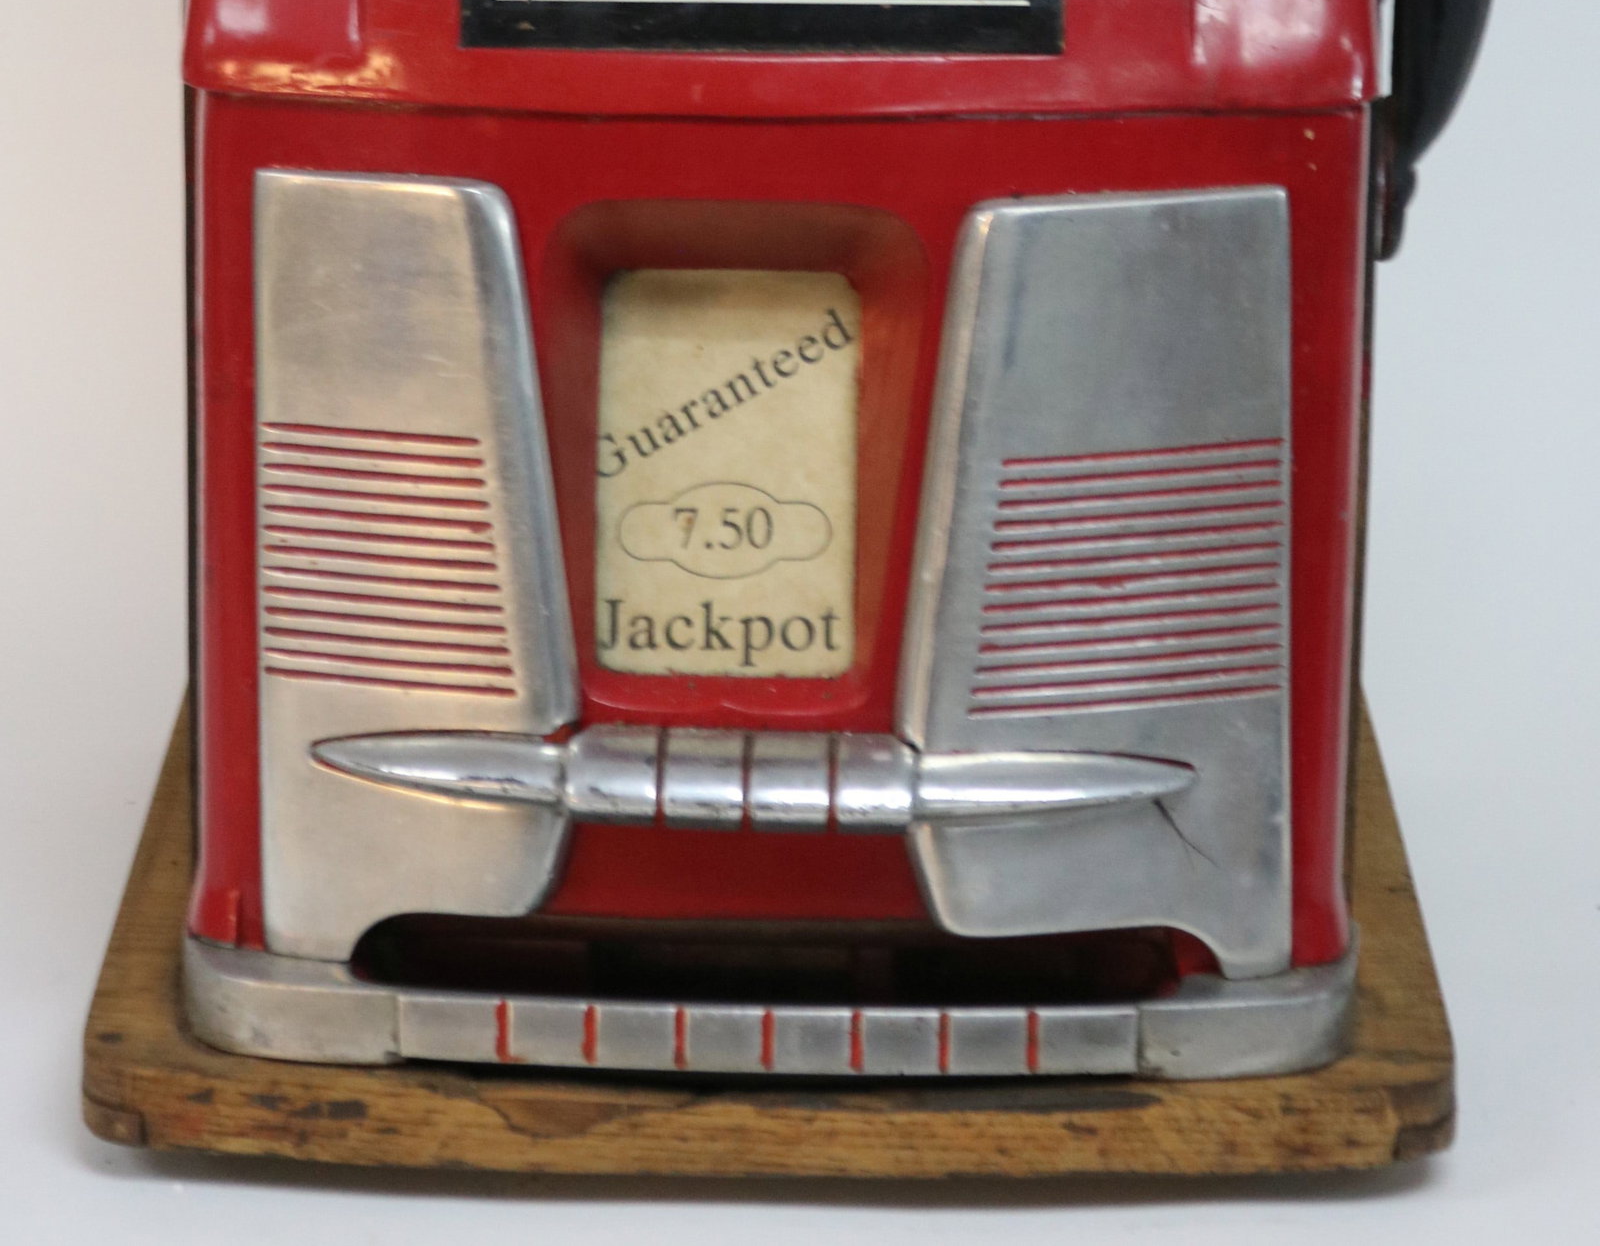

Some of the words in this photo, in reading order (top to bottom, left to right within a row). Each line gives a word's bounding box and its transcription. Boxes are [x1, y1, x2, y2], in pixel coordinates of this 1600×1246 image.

[595, 307, 856, 479] Guaranteed
[674, 506, 774, 550] 7.50
[600, 599, 841, 667] Jackpot
